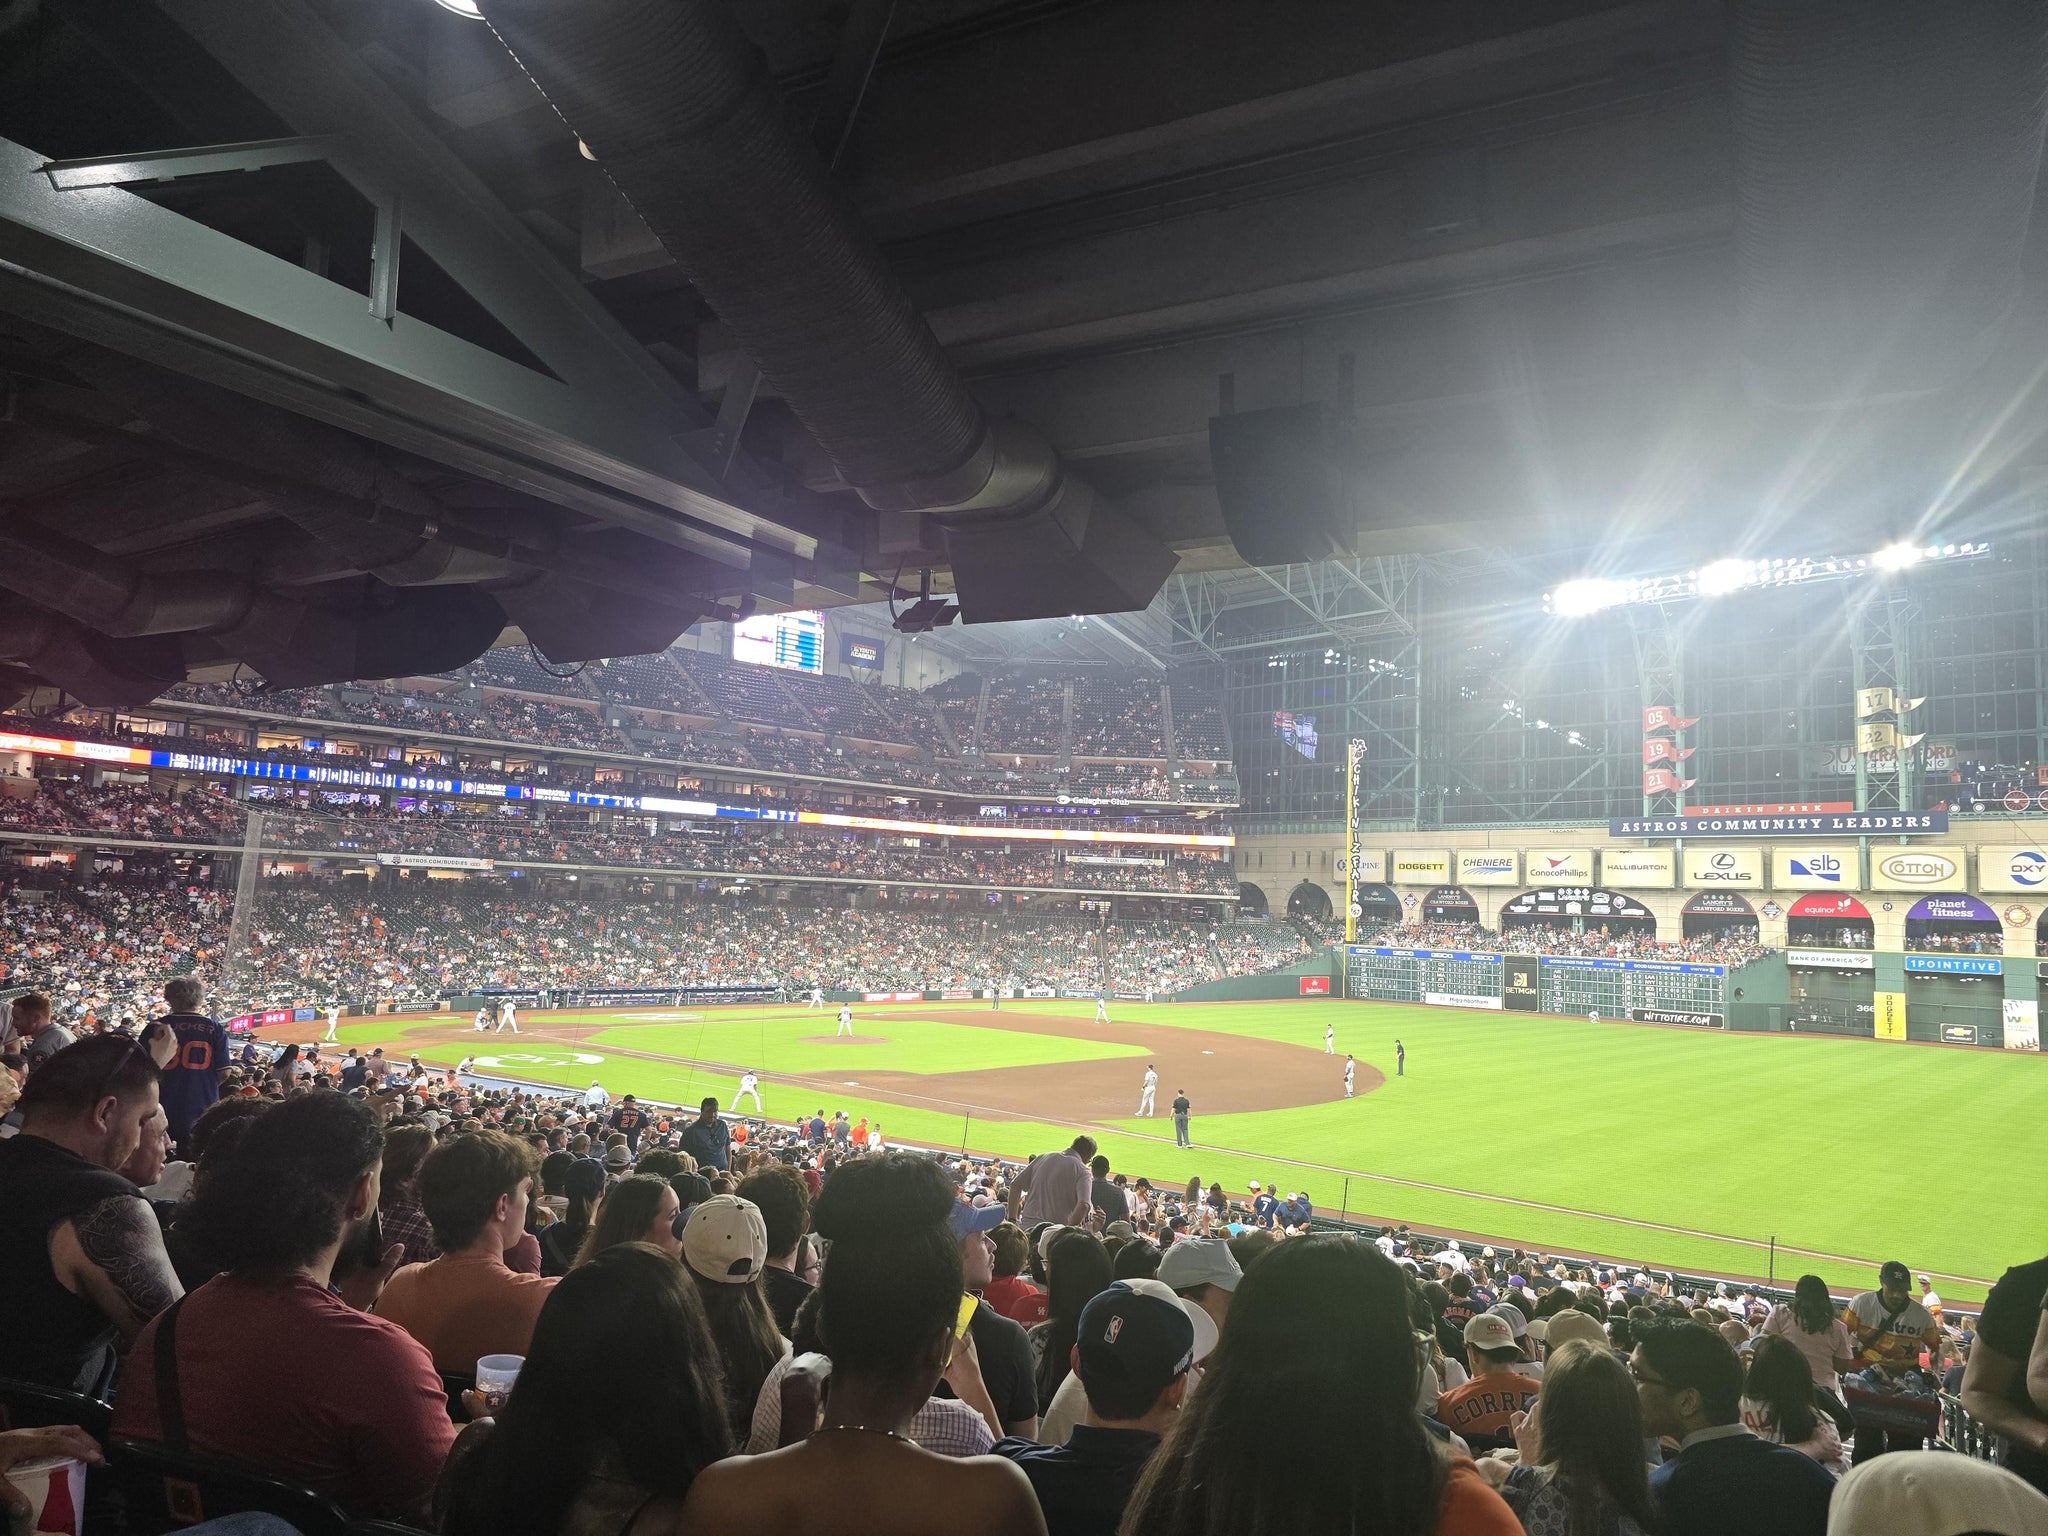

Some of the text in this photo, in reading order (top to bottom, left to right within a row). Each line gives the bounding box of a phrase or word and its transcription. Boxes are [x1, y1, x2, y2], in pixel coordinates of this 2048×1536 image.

[1865, 693, 1883, 708] 17
[1648, 711, 1664, 724] 05
[1864, 730, 1883, 744] 22
[1649, 744, 1664, 756] 19
[309, 769, 316, 778] R
[332, 770, 338, 780] H
[354, 773, 360, 782] E
[401, 776, 417, 788] B 0
[420, 776, 435, 790] S 0
[1648, 774, 1662, 786] 21
[444, 779, 452, 792] 0
[477, 782, 506, 791] ALVAREZ
[1073, 797, 1110, 806] Gallagher
[1350, 764, 1362, 830] CHIKIN
[627, 798, 634, 808] K
[1620, 816, 1932, 832] ASTROS COMMUNITY LEADERS
[1462, 858, 1513, 868] CHENIERE
[1810, 855, 1840, 871] slb
[1530, 868, 1588, 878] ConocoPhillips
[1694, 872, 1751, 881] LEXUS
[1350, 855, 1361, 903] FAIR
[1927, 899, 1966, 909] planet
[1804, 906, 1835, 915] equinor
[1932, 908, 1974, 918] fitness
[1911, 960, 1996, 971] 1POINTFIVE
[1505, 987, 1536, 995] BETMGM
[266, 1014, 285, 1023] H-E-B
[1644, 1011, 1710, 1026] NITTOTIRE.COM
[620, 1115, 638, 1128] 27
[1262, 1201, 1268, 1211] 7
